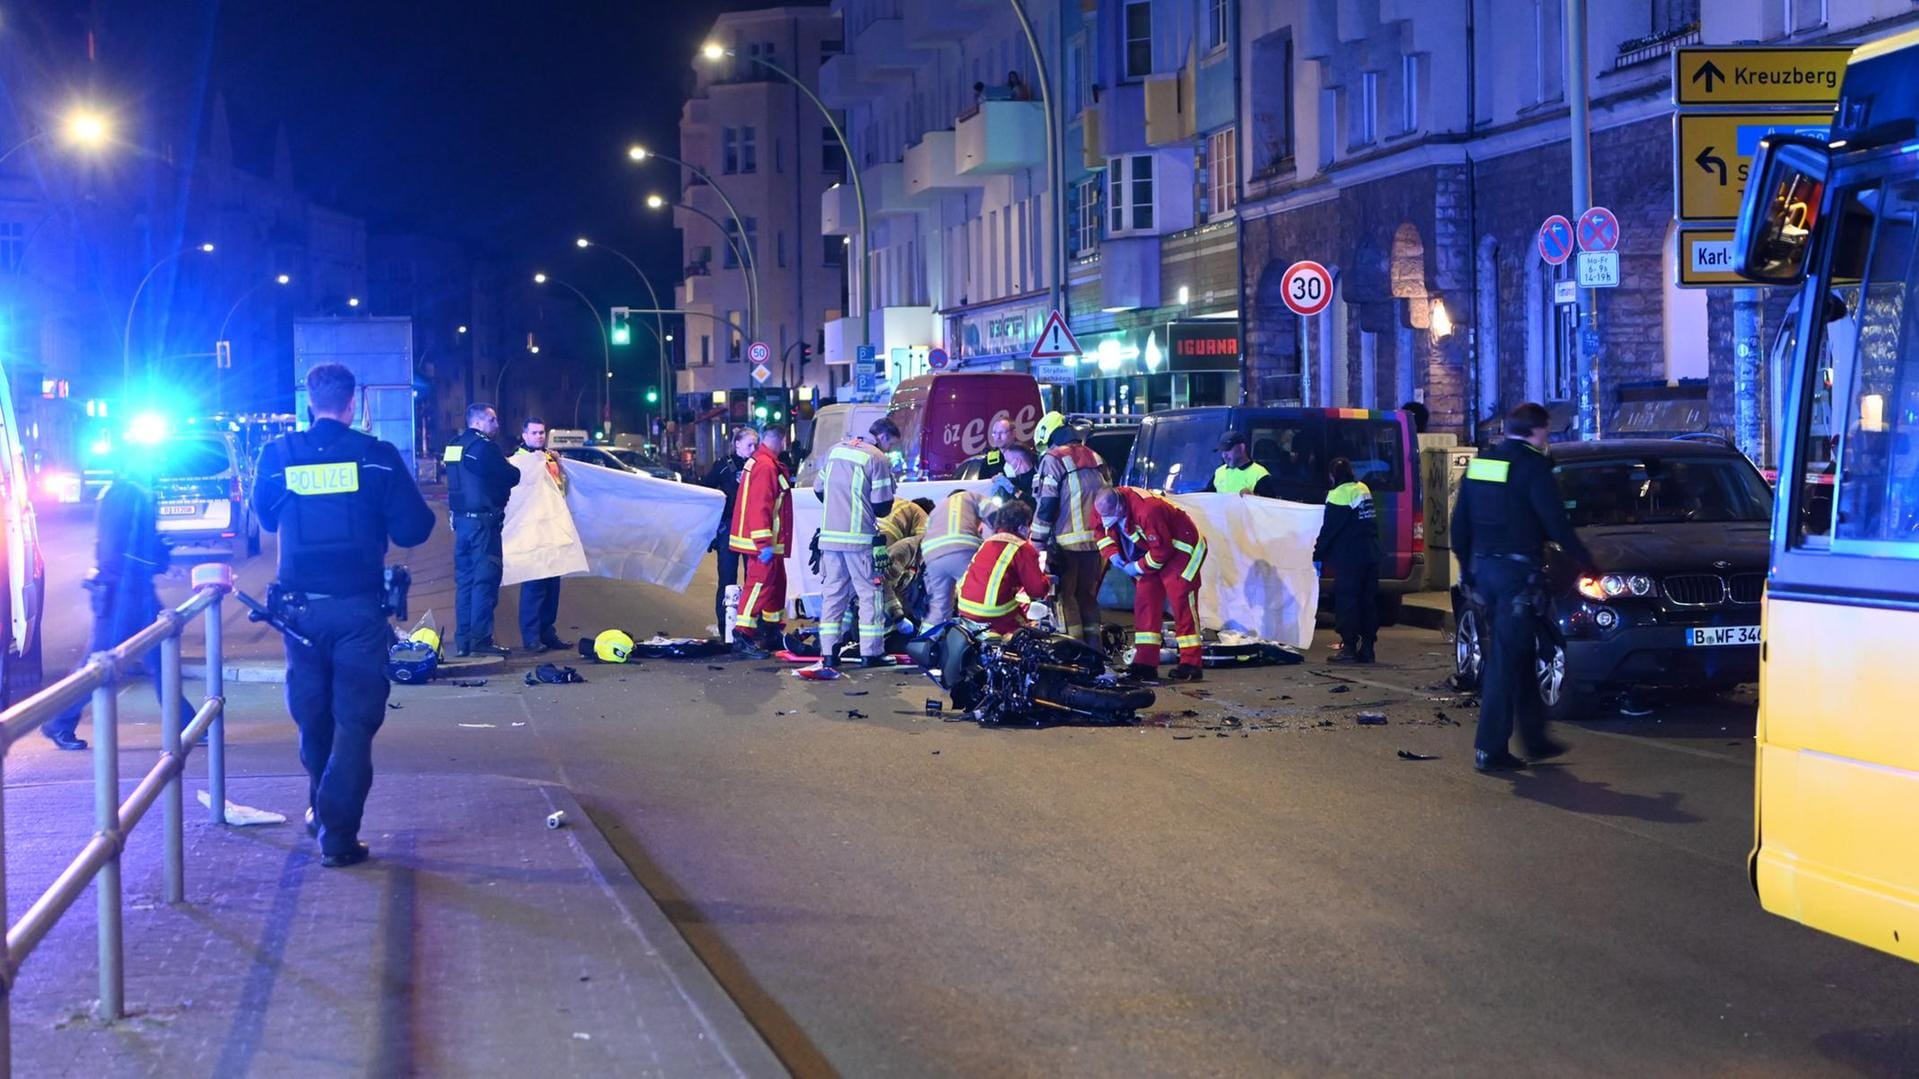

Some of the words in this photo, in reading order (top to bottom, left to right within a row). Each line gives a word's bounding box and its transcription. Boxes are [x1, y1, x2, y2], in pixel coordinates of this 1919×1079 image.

[1735, 67, 1836, 88] Kreuzberg
[1293, 277, 1321, 300] 30
[753, 347, 765, 358] 50
[1177, 338, 1237, 355] IGUANA
[943, 423, 960, 445] ÖZ
[290, 467, 355, 490] POLIZEI
[1695, 629, 1705, 645] B
[1715, 629, 1735, 643] WF
